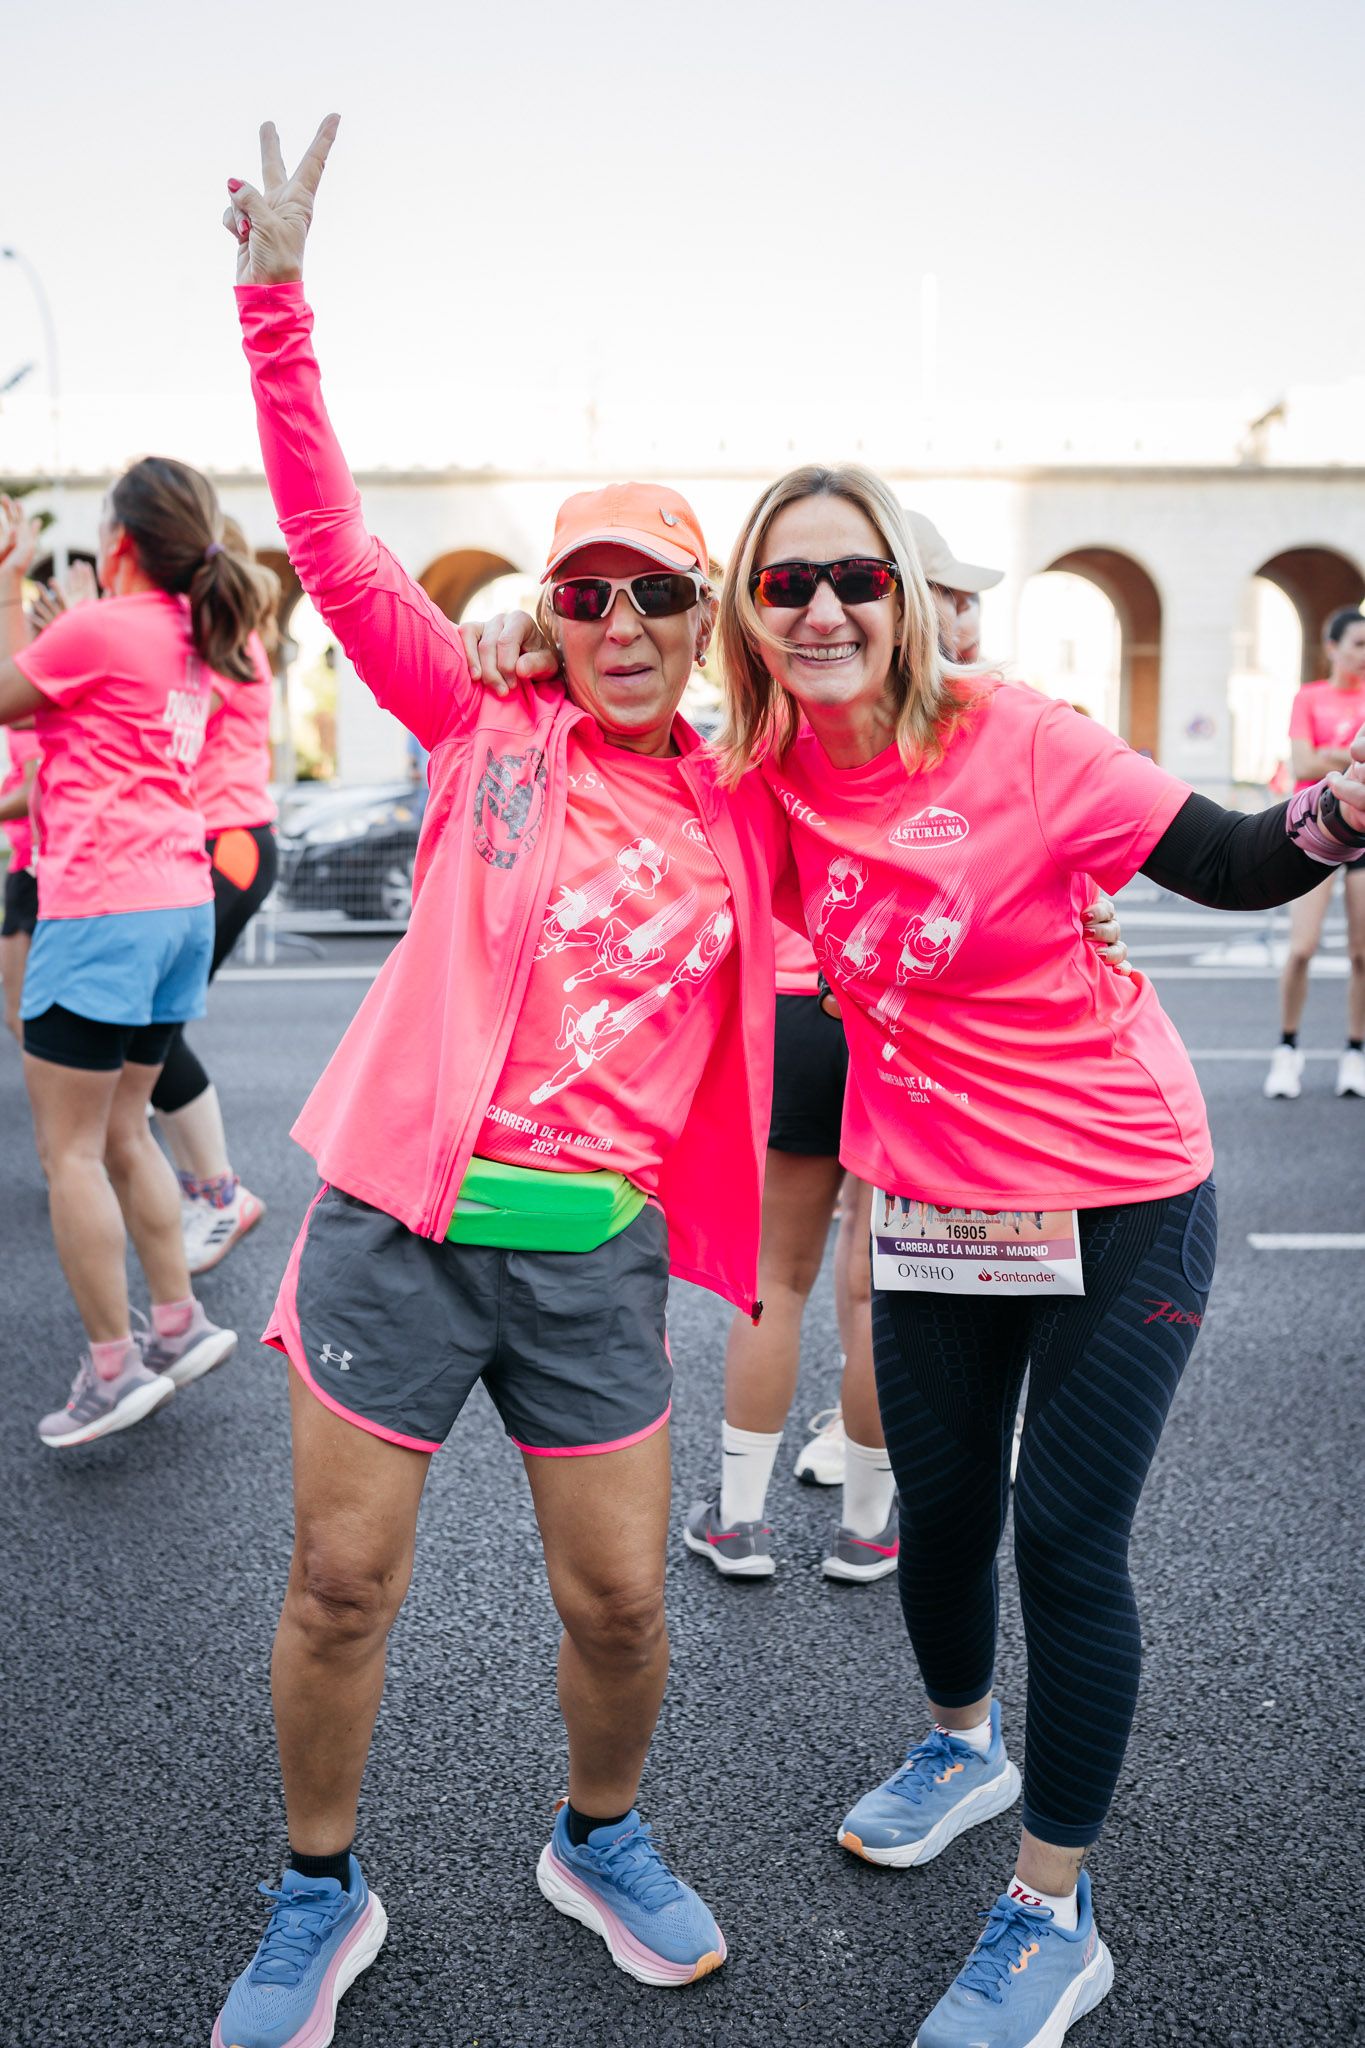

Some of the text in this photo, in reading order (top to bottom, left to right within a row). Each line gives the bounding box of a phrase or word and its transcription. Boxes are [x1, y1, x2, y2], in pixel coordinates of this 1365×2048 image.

[891, 824, 964, 841] ASTURIANA
[918, 1075, 933, 1090] LA
[907, 1090, 931, 1104] 2024
[485, 1104, 615, 1152] CARRERA DE LA MUJER
[529, 1138, 561, 1157] 2024
[945, 1224, 987, 1240] 16905
[894, 1241, 1049, 1257] CARRERA DE LA MUJER MADRID
[897, 1262, 1056, 1283] OYSHO Santander
